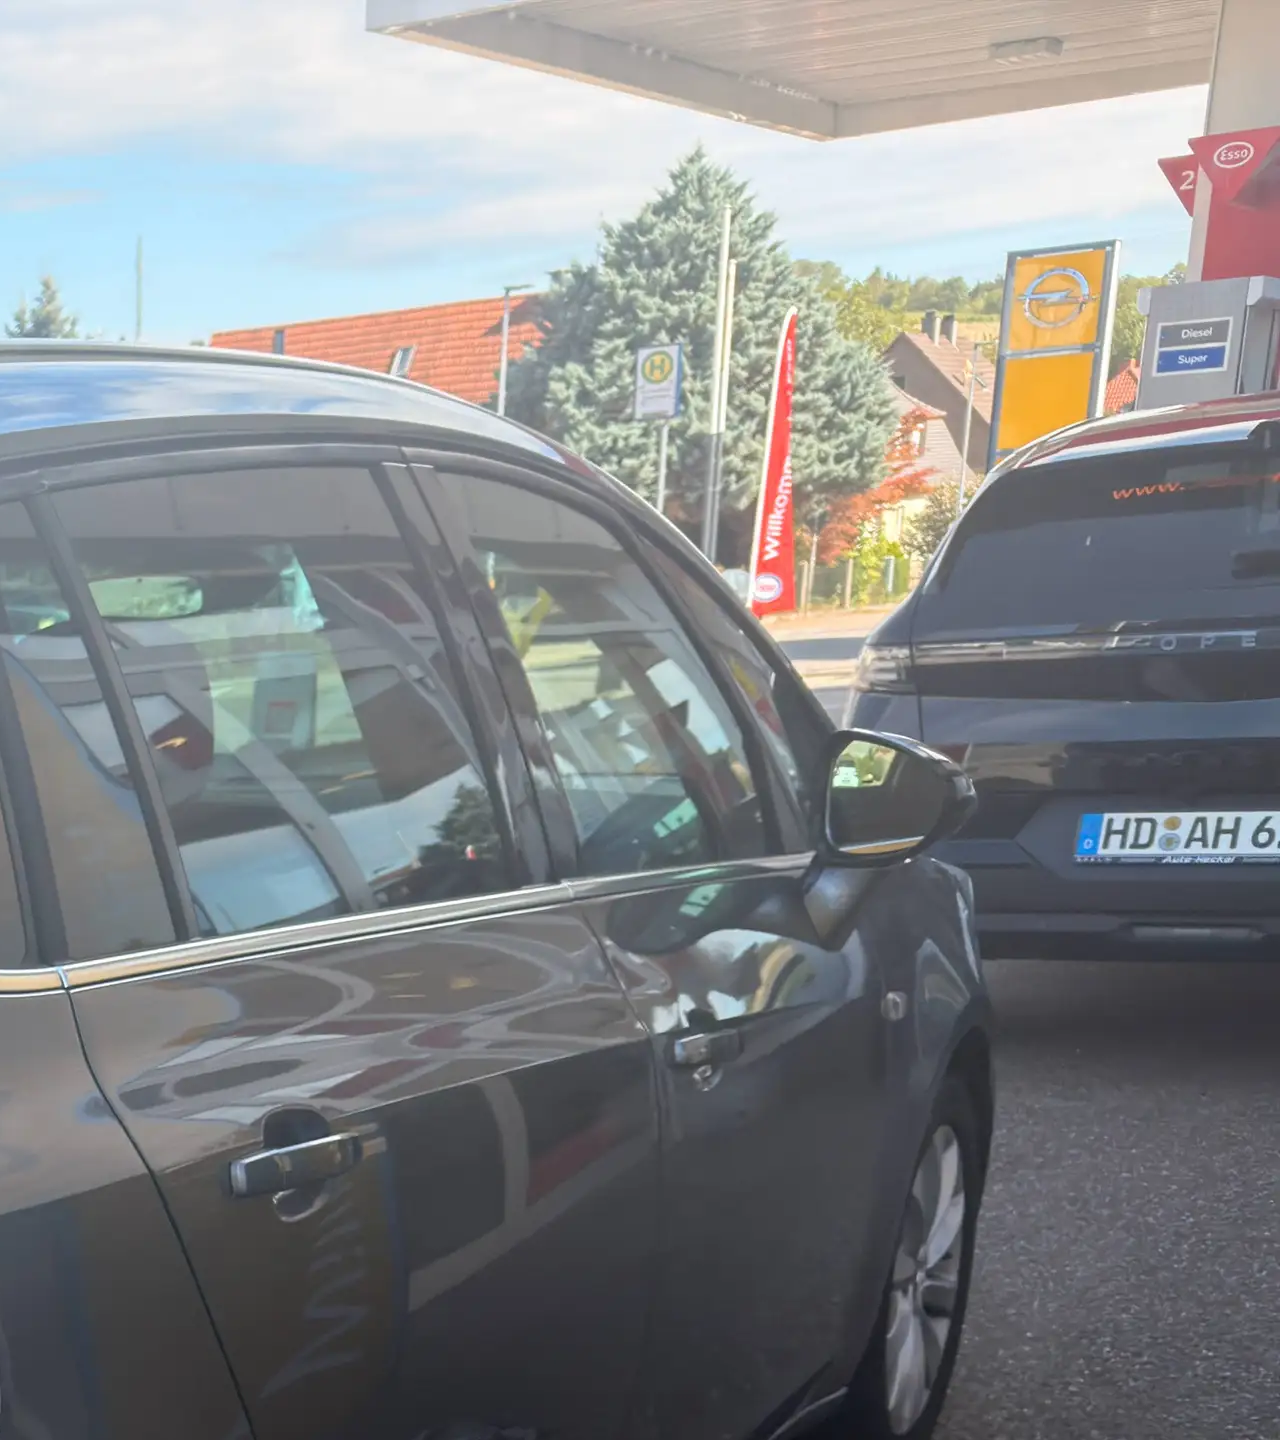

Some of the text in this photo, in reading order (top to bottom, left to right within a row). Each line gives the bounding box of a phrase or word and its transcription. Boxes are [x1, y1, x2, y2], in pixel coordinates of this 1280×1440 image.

[1179, 169, 1195, 191] 2
[1181, 326, 1213, 339] Diesel
[1177, 354, 1209, 366] Super
[1101, 814, 1280, 850] HD AH 6
